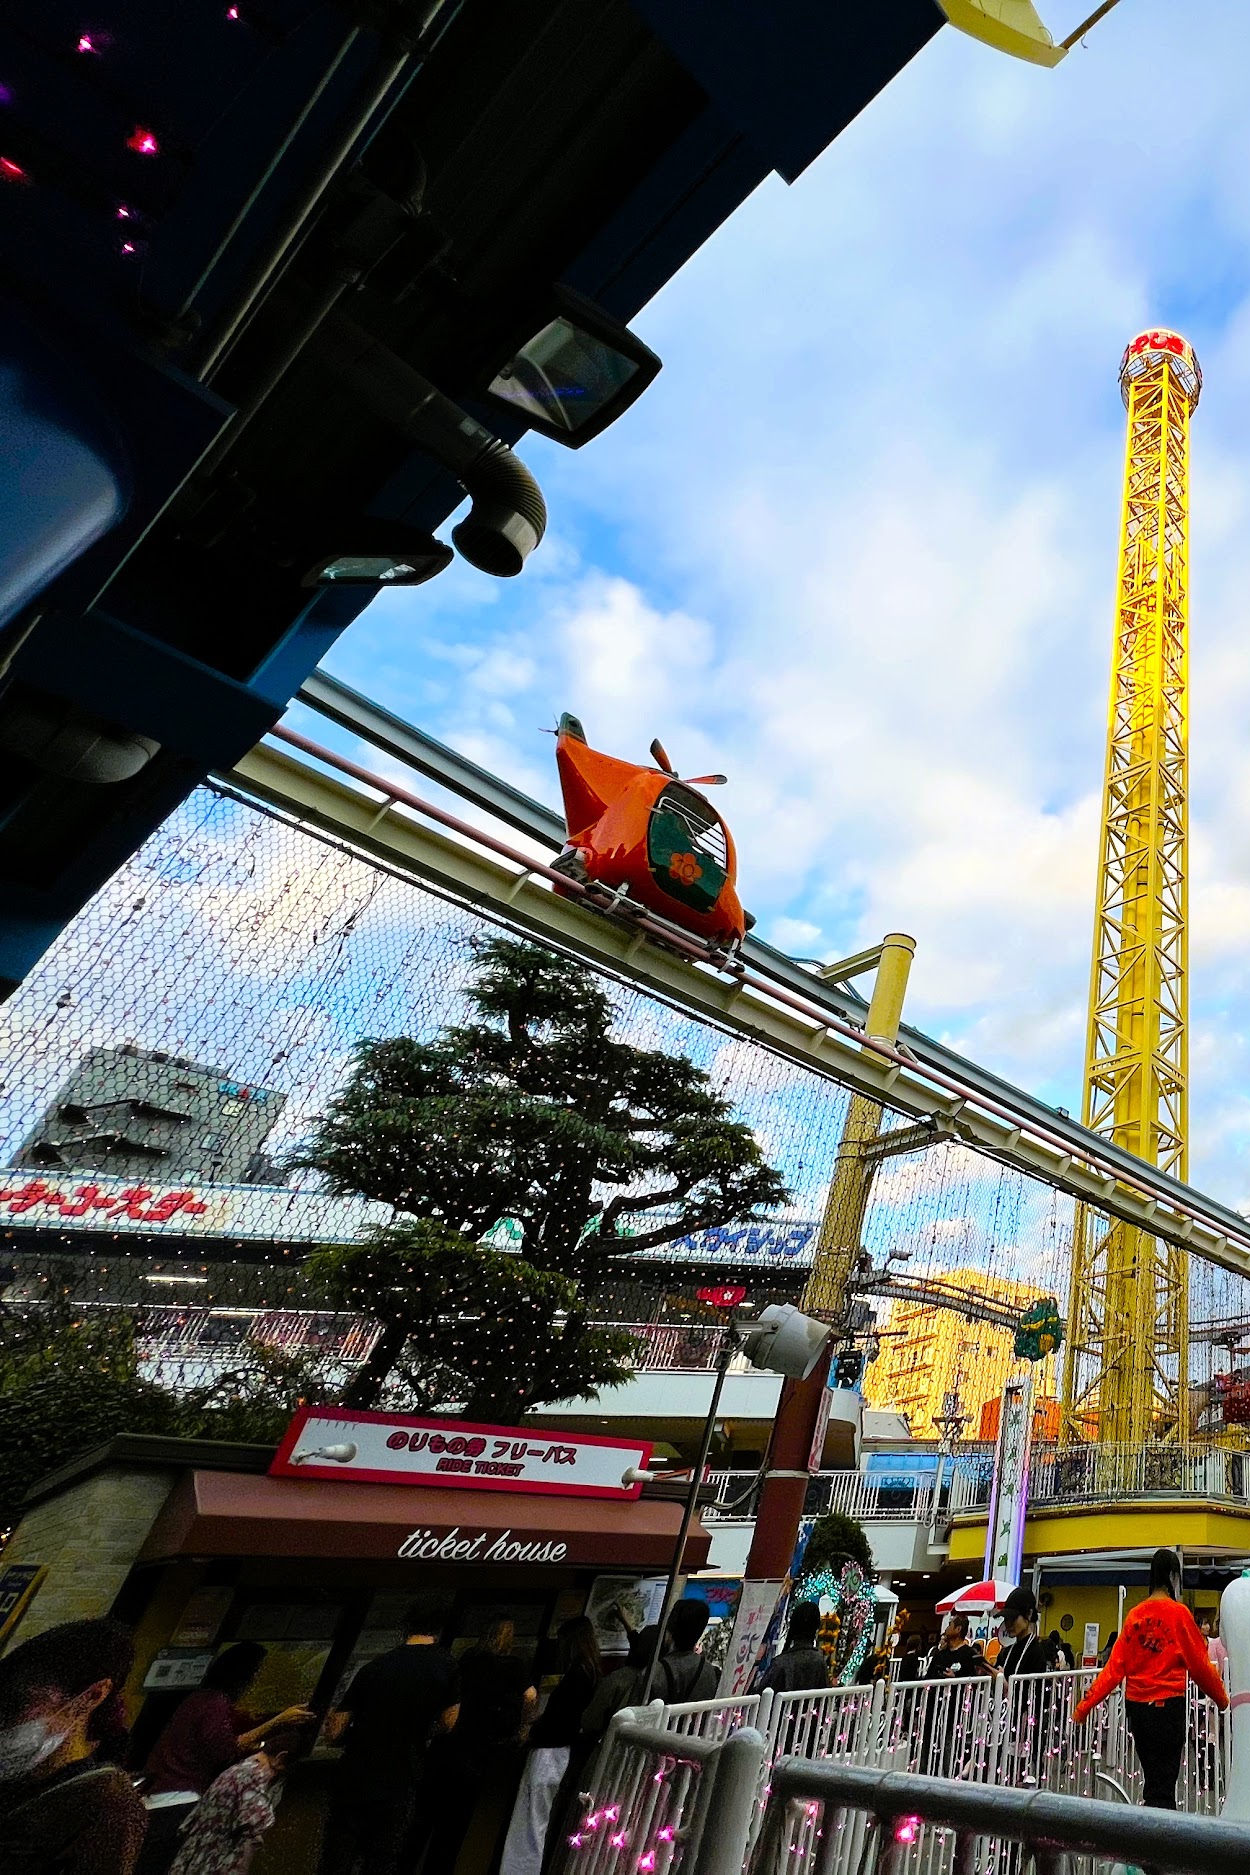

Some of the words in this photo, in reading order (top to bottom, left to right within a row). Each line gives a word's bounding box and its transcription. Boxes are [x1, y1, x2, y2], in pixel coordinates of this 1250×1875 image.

[386, 1431, 487, 1457] のりもの券
[491, 1441, 577, 1465] フリーパス
[436, 1458, 473, 1472] RIDE
[474, 1461, 525, 1476] TICKET
[397, 1527, 487, 1560] ticket
[484, 1529, 567, 1562] house
